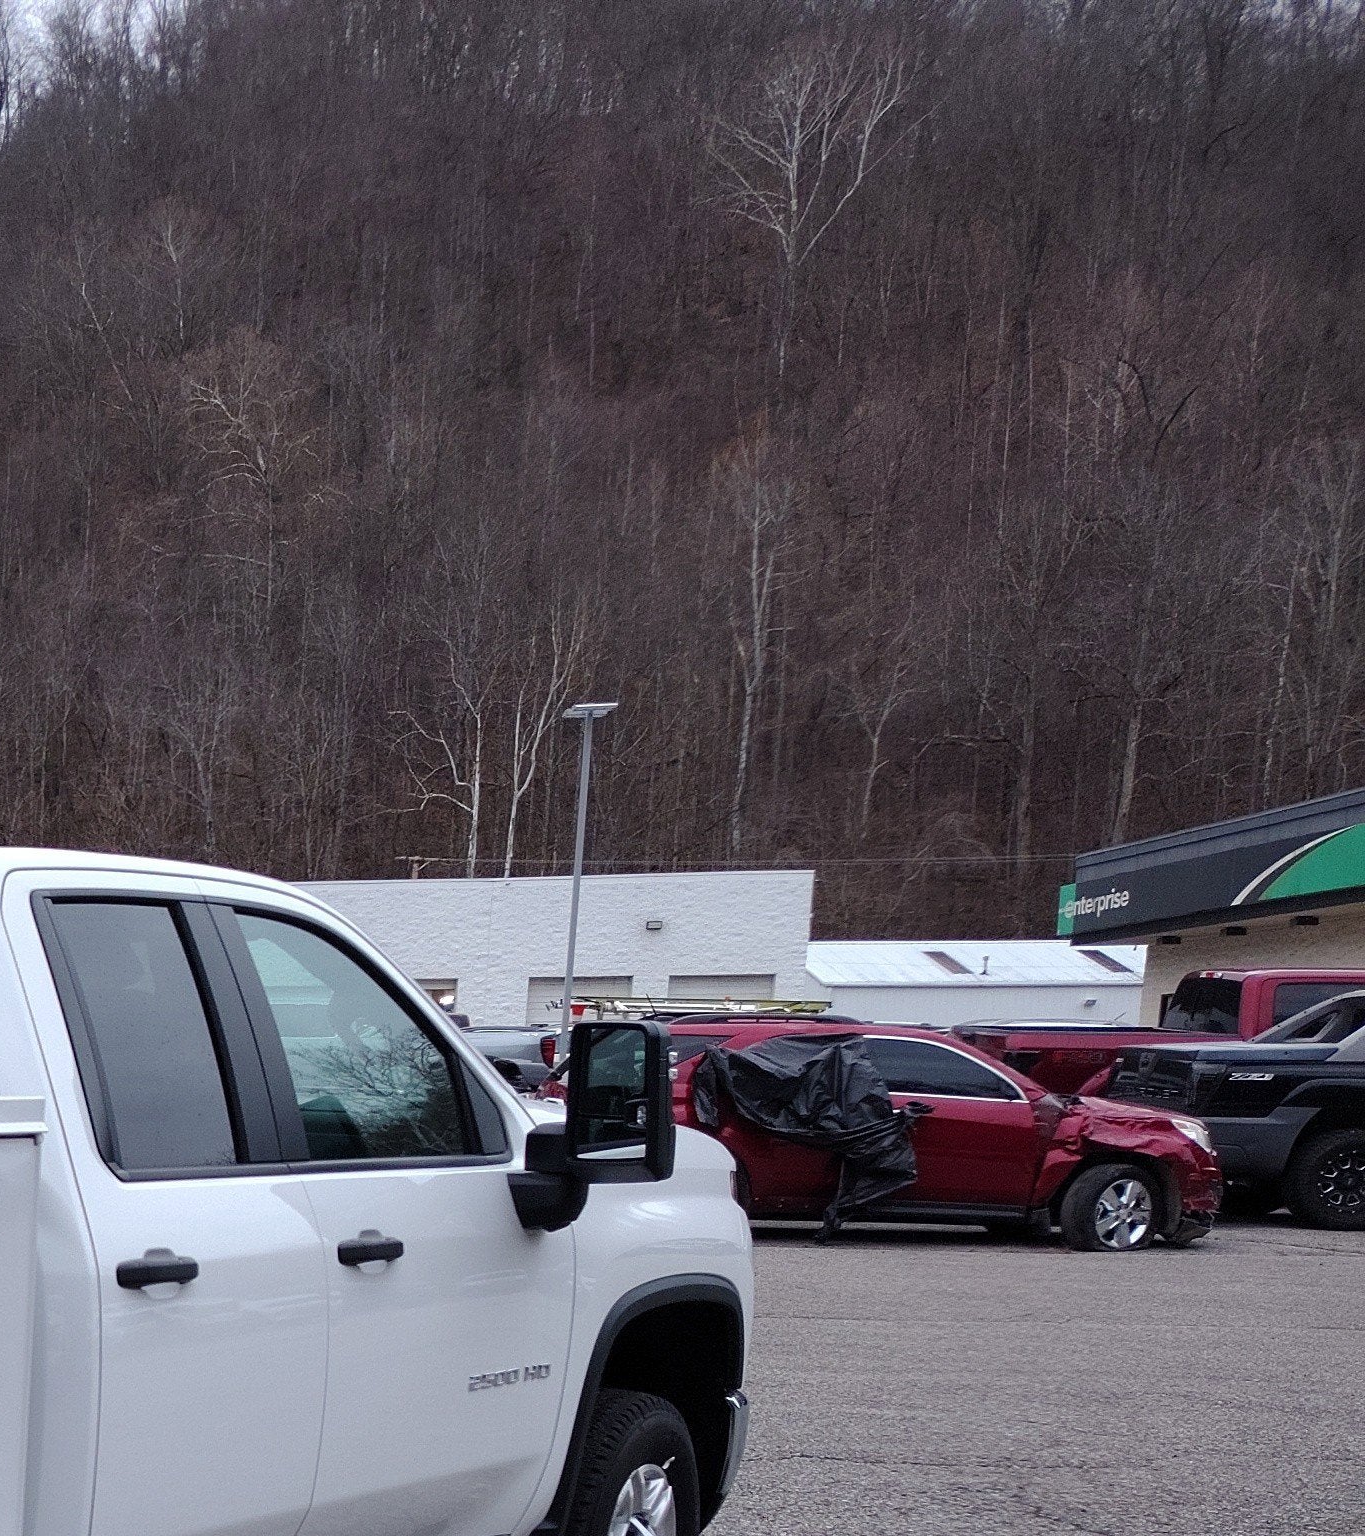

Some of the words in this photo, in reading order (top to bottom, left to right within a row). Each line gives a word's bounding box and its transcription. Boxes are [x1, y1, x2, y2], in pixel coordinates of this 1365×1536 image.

[1065, 888, 1129, 918] enterprise
[468, 1368, 519, 1392] 2500
[523, 1364, 551, 1381] HD
